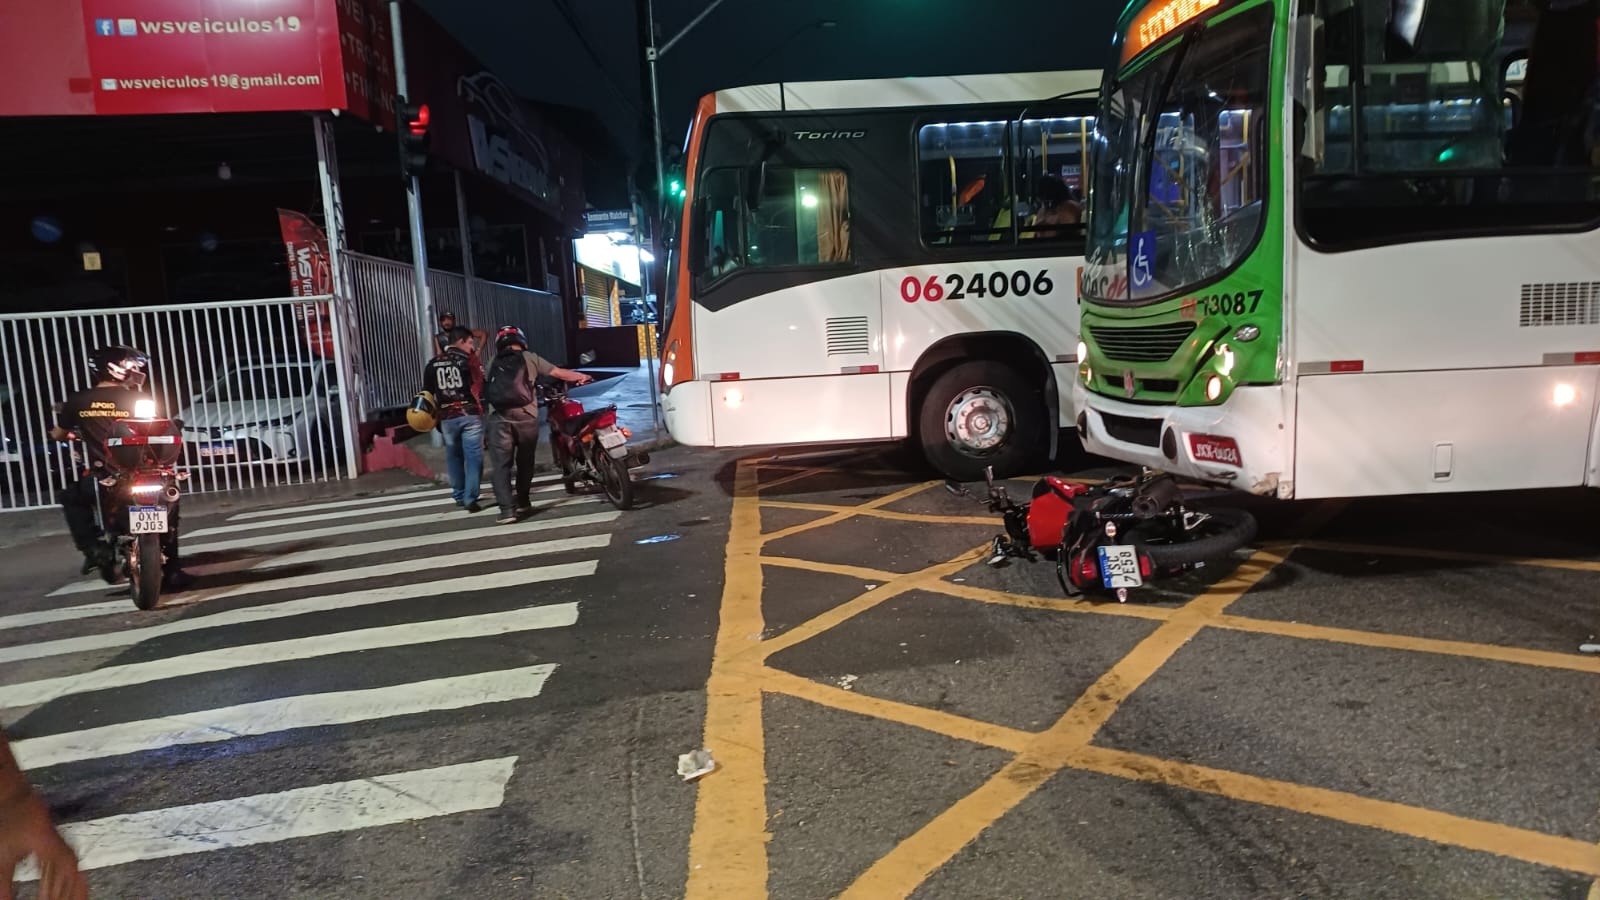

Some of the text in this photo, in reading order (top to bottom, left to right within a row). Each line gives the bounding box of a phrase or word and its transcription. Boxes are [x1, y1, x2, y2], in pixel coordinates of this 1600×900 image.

[140, 16, 301, 34] wsveiculos19
[119, 74, 320, 90] wsveiculos19@gmail.com
[793, 128, 866, 141] Torino
[297, 247, 313, 278] WS
[900, 269, 1054, 303] 0624006
[436, 366, 463, 390] 039
[138, 512, 160, 522] OXM
[1119, 551, 1137, 583] 7E58
